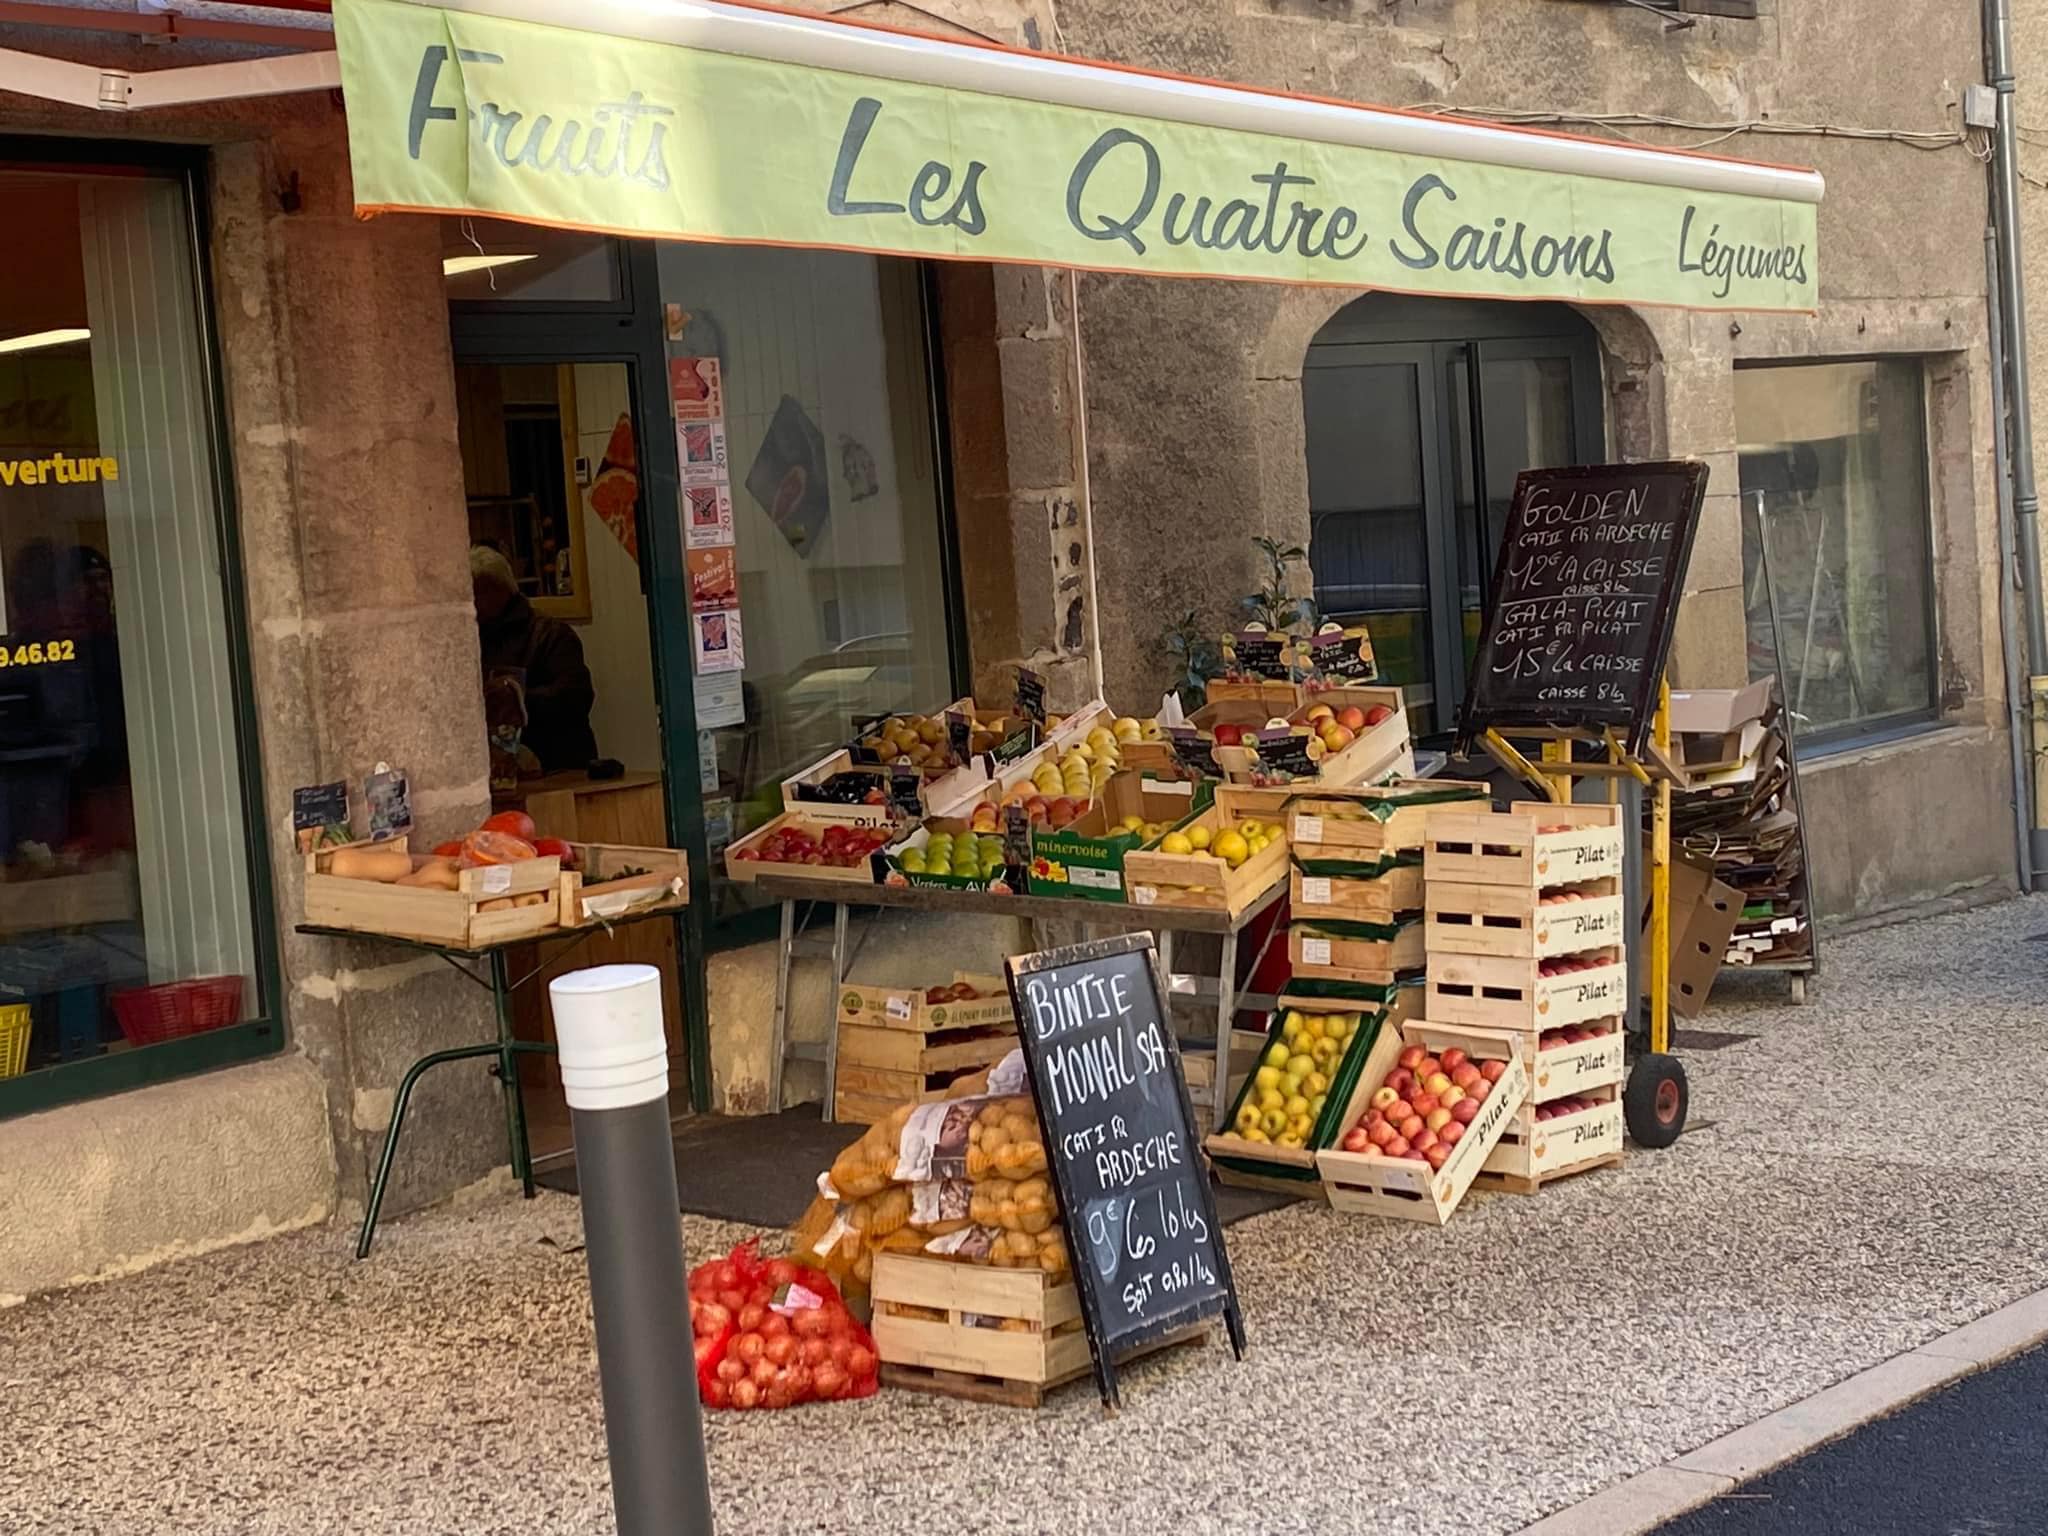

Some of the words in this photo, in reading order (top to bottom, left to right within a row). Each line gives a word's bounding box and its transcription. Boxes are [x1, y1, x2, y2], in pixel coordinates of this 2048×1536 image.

[408, 45, 675, 192] Fruits
[826, 97, 987, 236] Les
[1065, 127, 1368, 261] Quatre
[1390, 173, 1616, 284] Saisons
[1678, 204, 1807, 298] Légumes
[0, 452, 119, 486] verture
[1594, 522, 1675, 544] ARDECHE
[1036, 839, 1108, 859] minervoise
[1575, 844, 1605, 865] Pilat
[1574, 913, 1605, 934] Pilat
[1577, 981, 1608, 1002] Pilat
[1575, 1052, 1605, 1075] Pilat
[1477, 1091, 1510, 1146] Pilat
[1574, 1122, 1605, 1144] Pilat
[1095, 1131, 1182, 1190] ARDECHE
